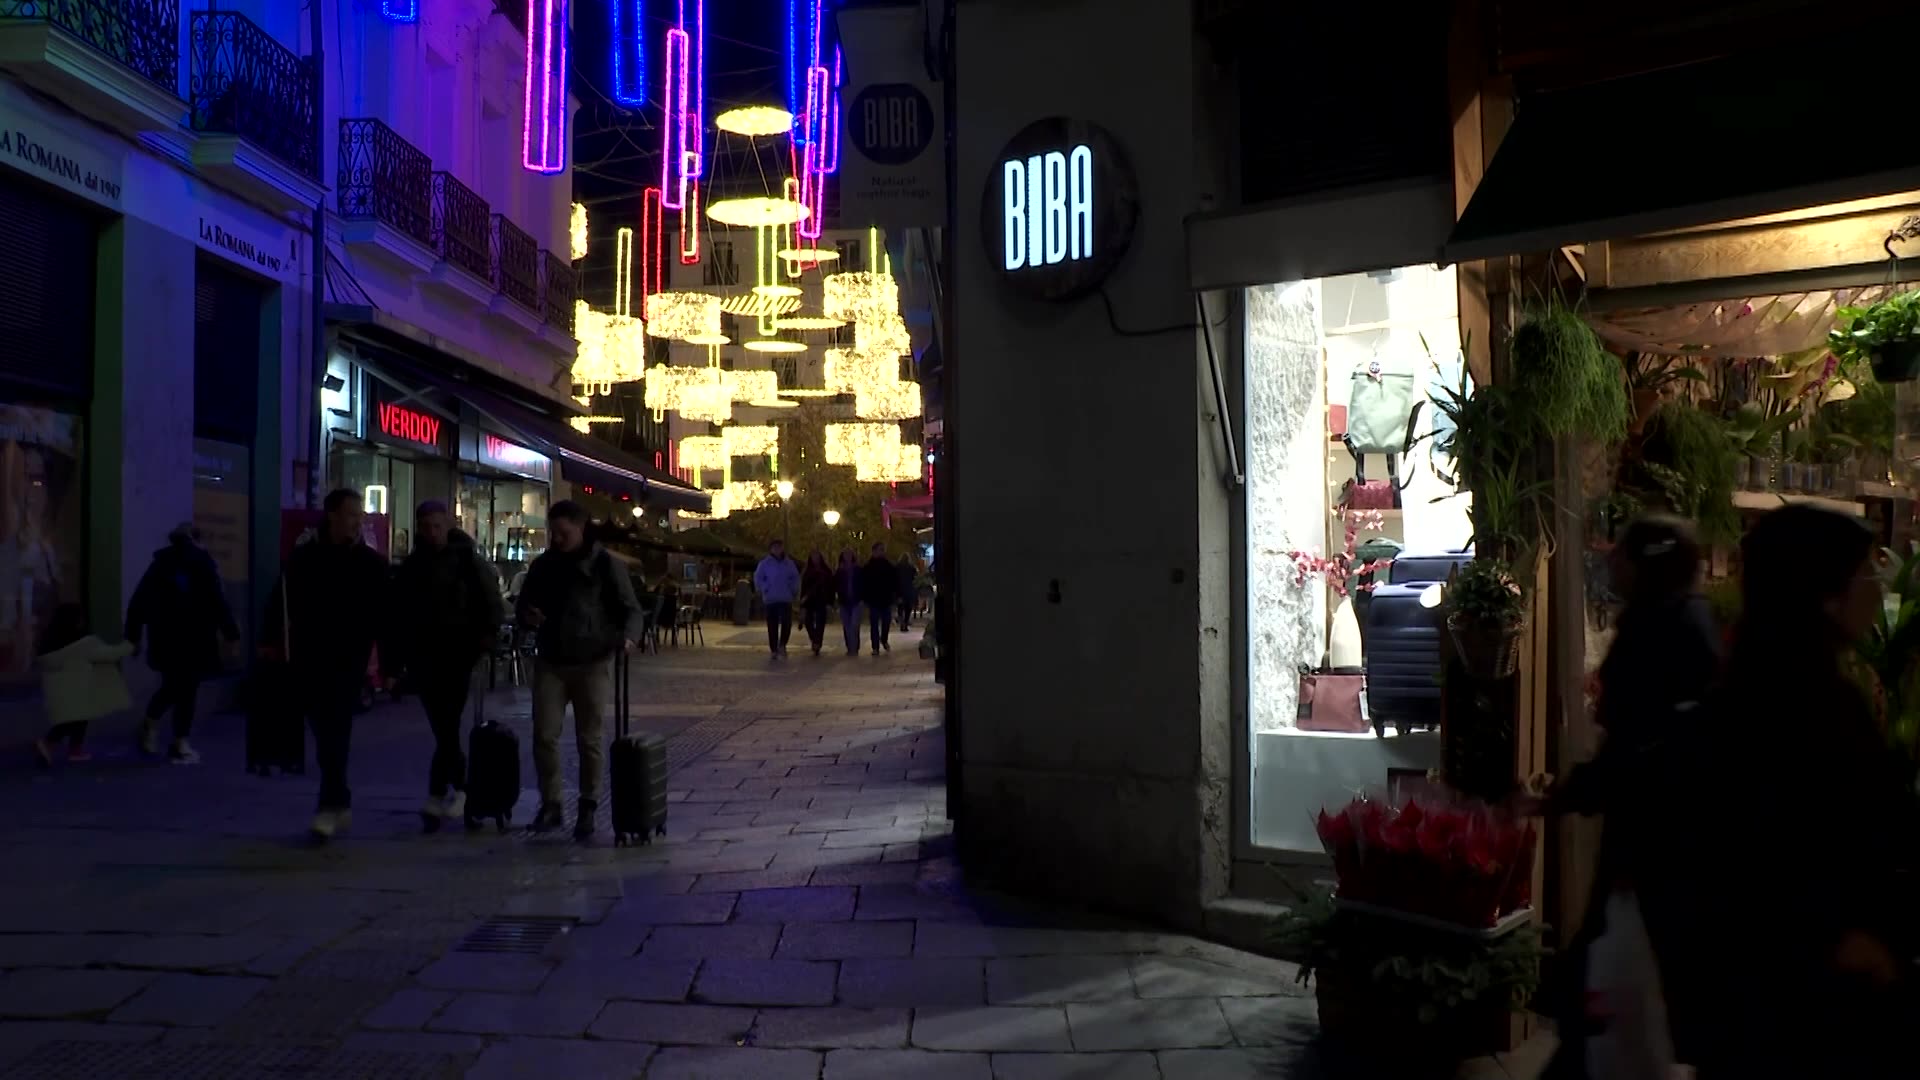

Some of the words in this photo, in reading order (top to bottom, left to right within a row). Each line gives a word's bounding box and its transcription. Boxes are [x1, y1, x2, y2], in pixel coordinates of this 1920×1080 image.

[863, 96, 919, 149] BIBA
[0, 130, 11, 152] A
[16, 131, 82, 184] ROMANA
[1004, 145, 1092, 270] BIBA
[215, 225, 256, 262] ROMANA
[378, 400, 441, 447] VERDOY
